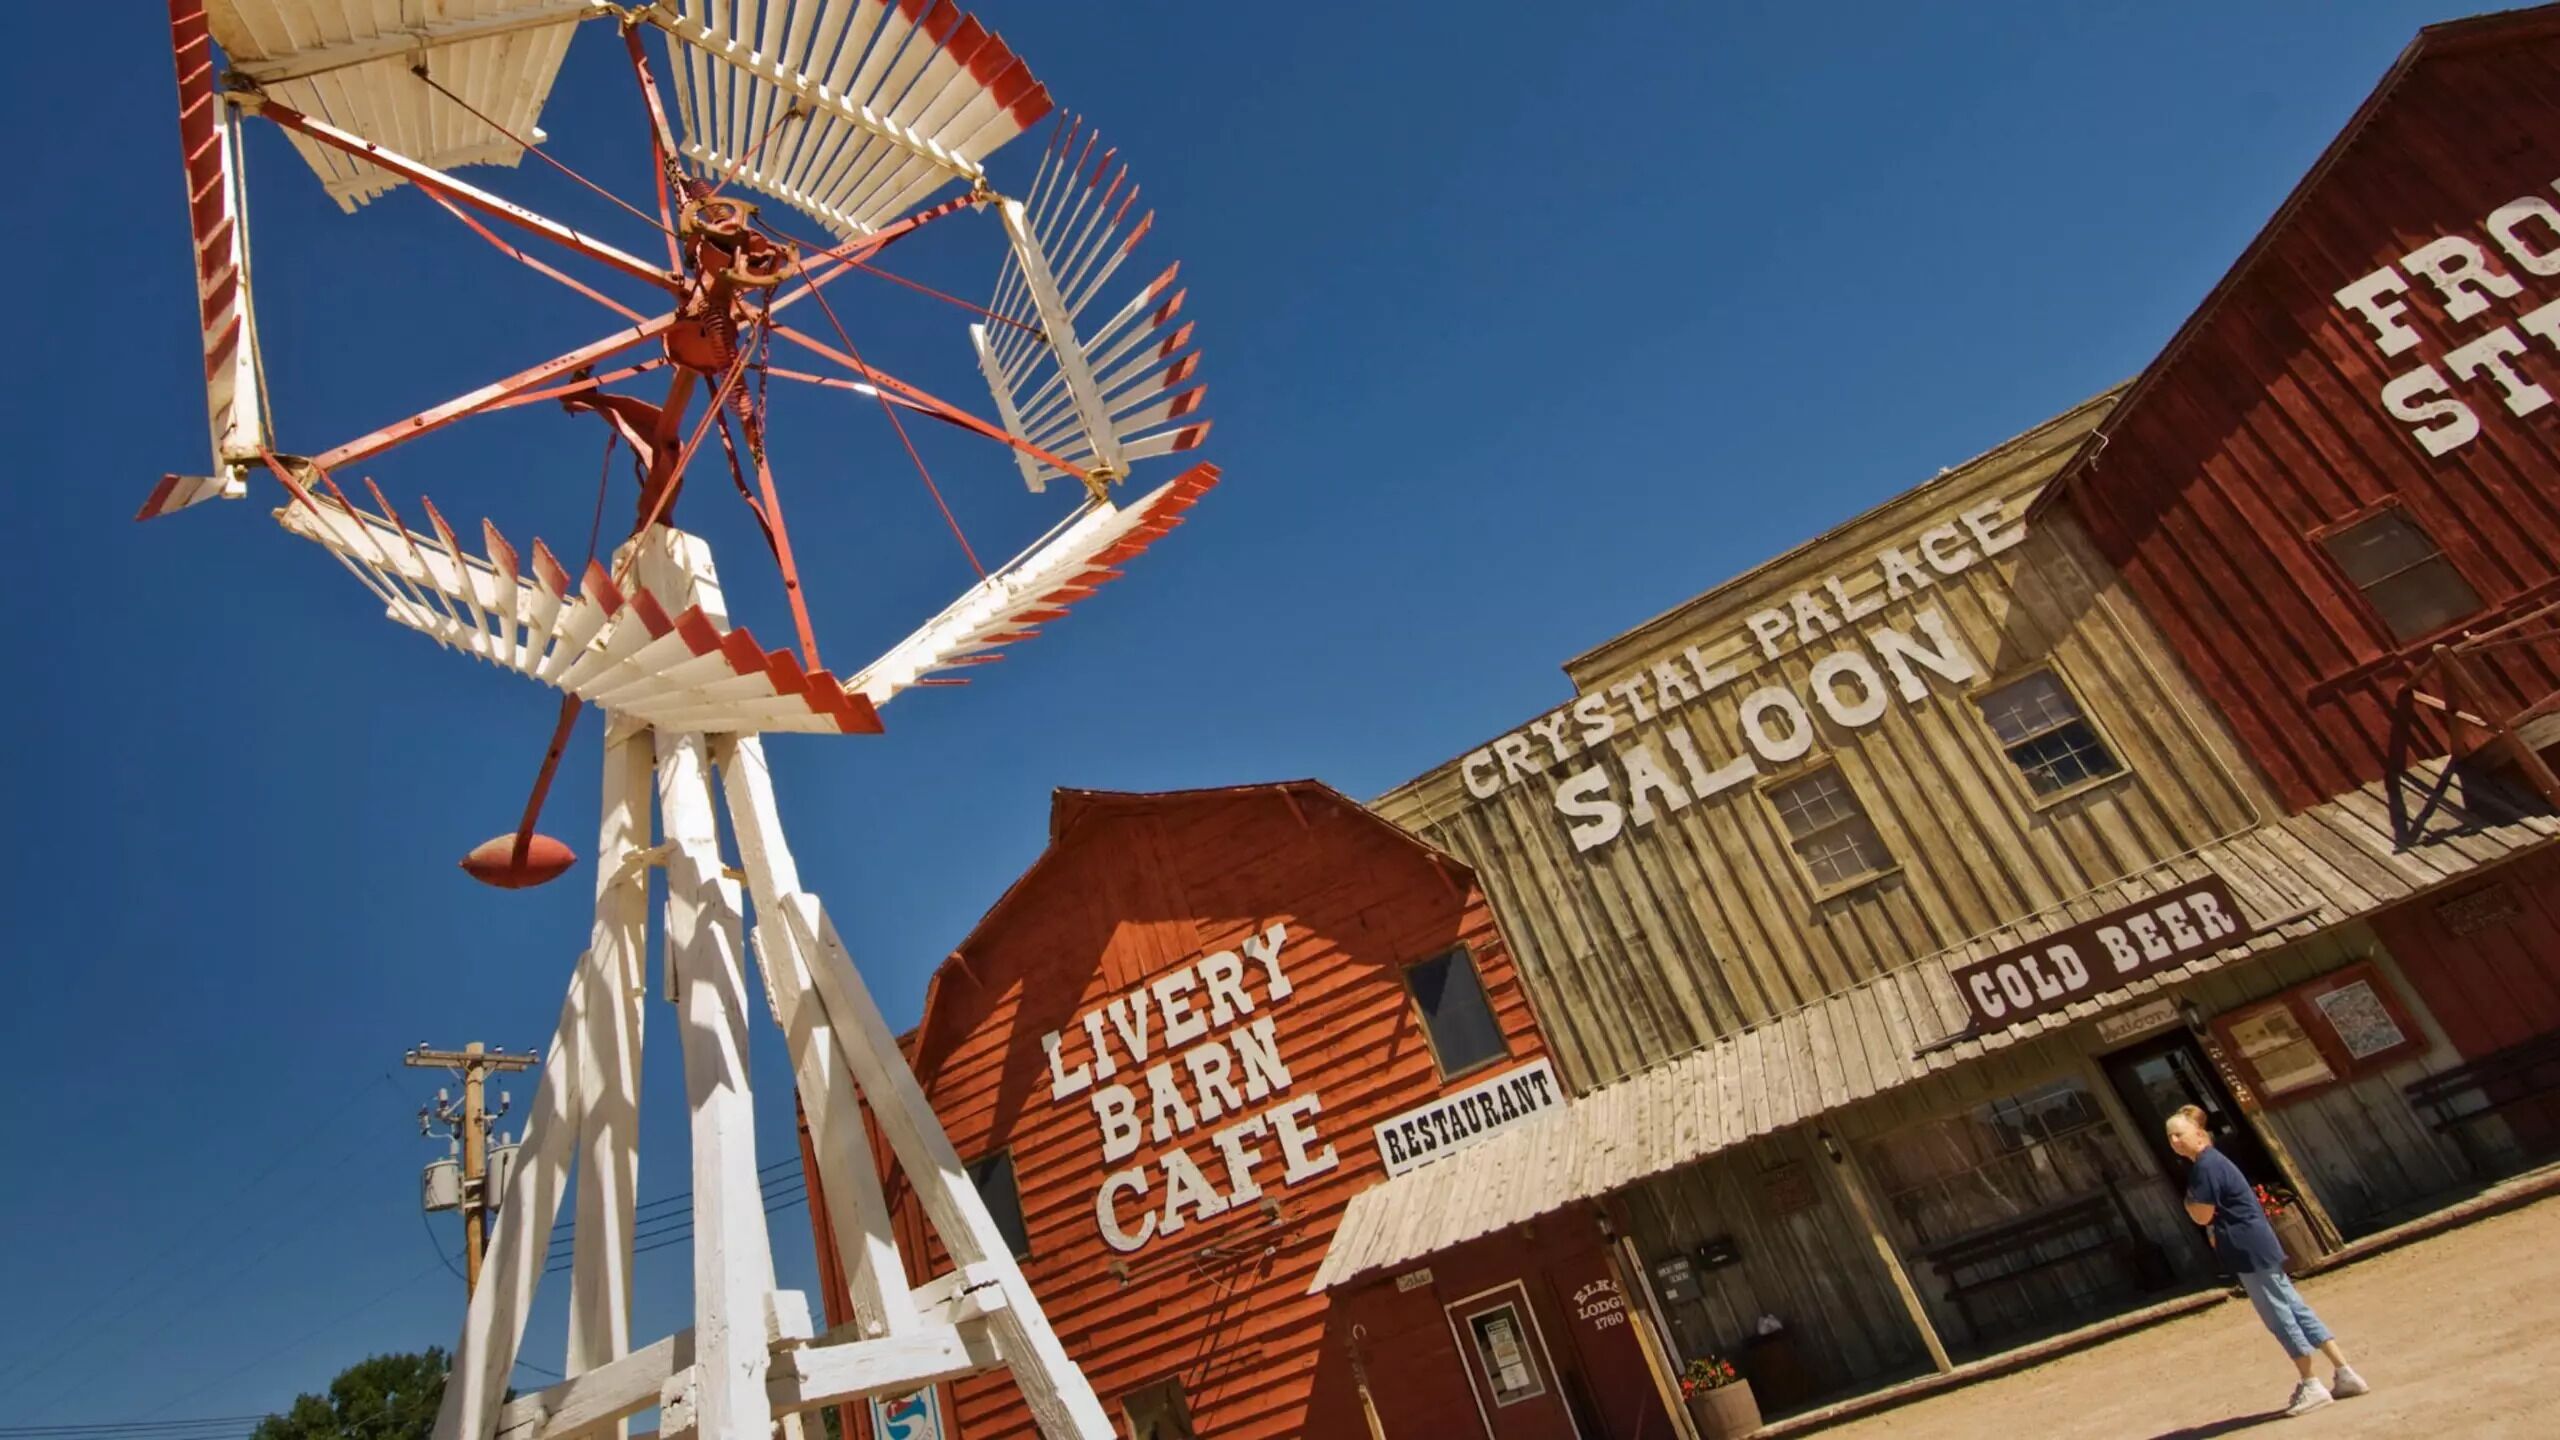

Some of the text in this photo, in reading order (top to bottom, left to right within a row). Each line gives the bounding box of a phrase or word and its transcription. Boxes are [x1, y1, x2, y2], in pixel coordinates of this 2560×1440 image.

[2333, 177, 2560, 358] FRO
[1461, 500, 2026, 800] CRYSTAL PALACE
[1555, 607, 1977, 853] SALOON
[1042, 922, 1295, 1102] LIVERY
[1969, 890, 2237, 1018] COLD BEER
[1091, 1016, 1293, 1165] BARN
[1383, 1069, 1552, 1165] RESTAURANT
[1096, 1093, 1340, 1253] CAFE
[1594, 1311, 1624, 1330] 1760
